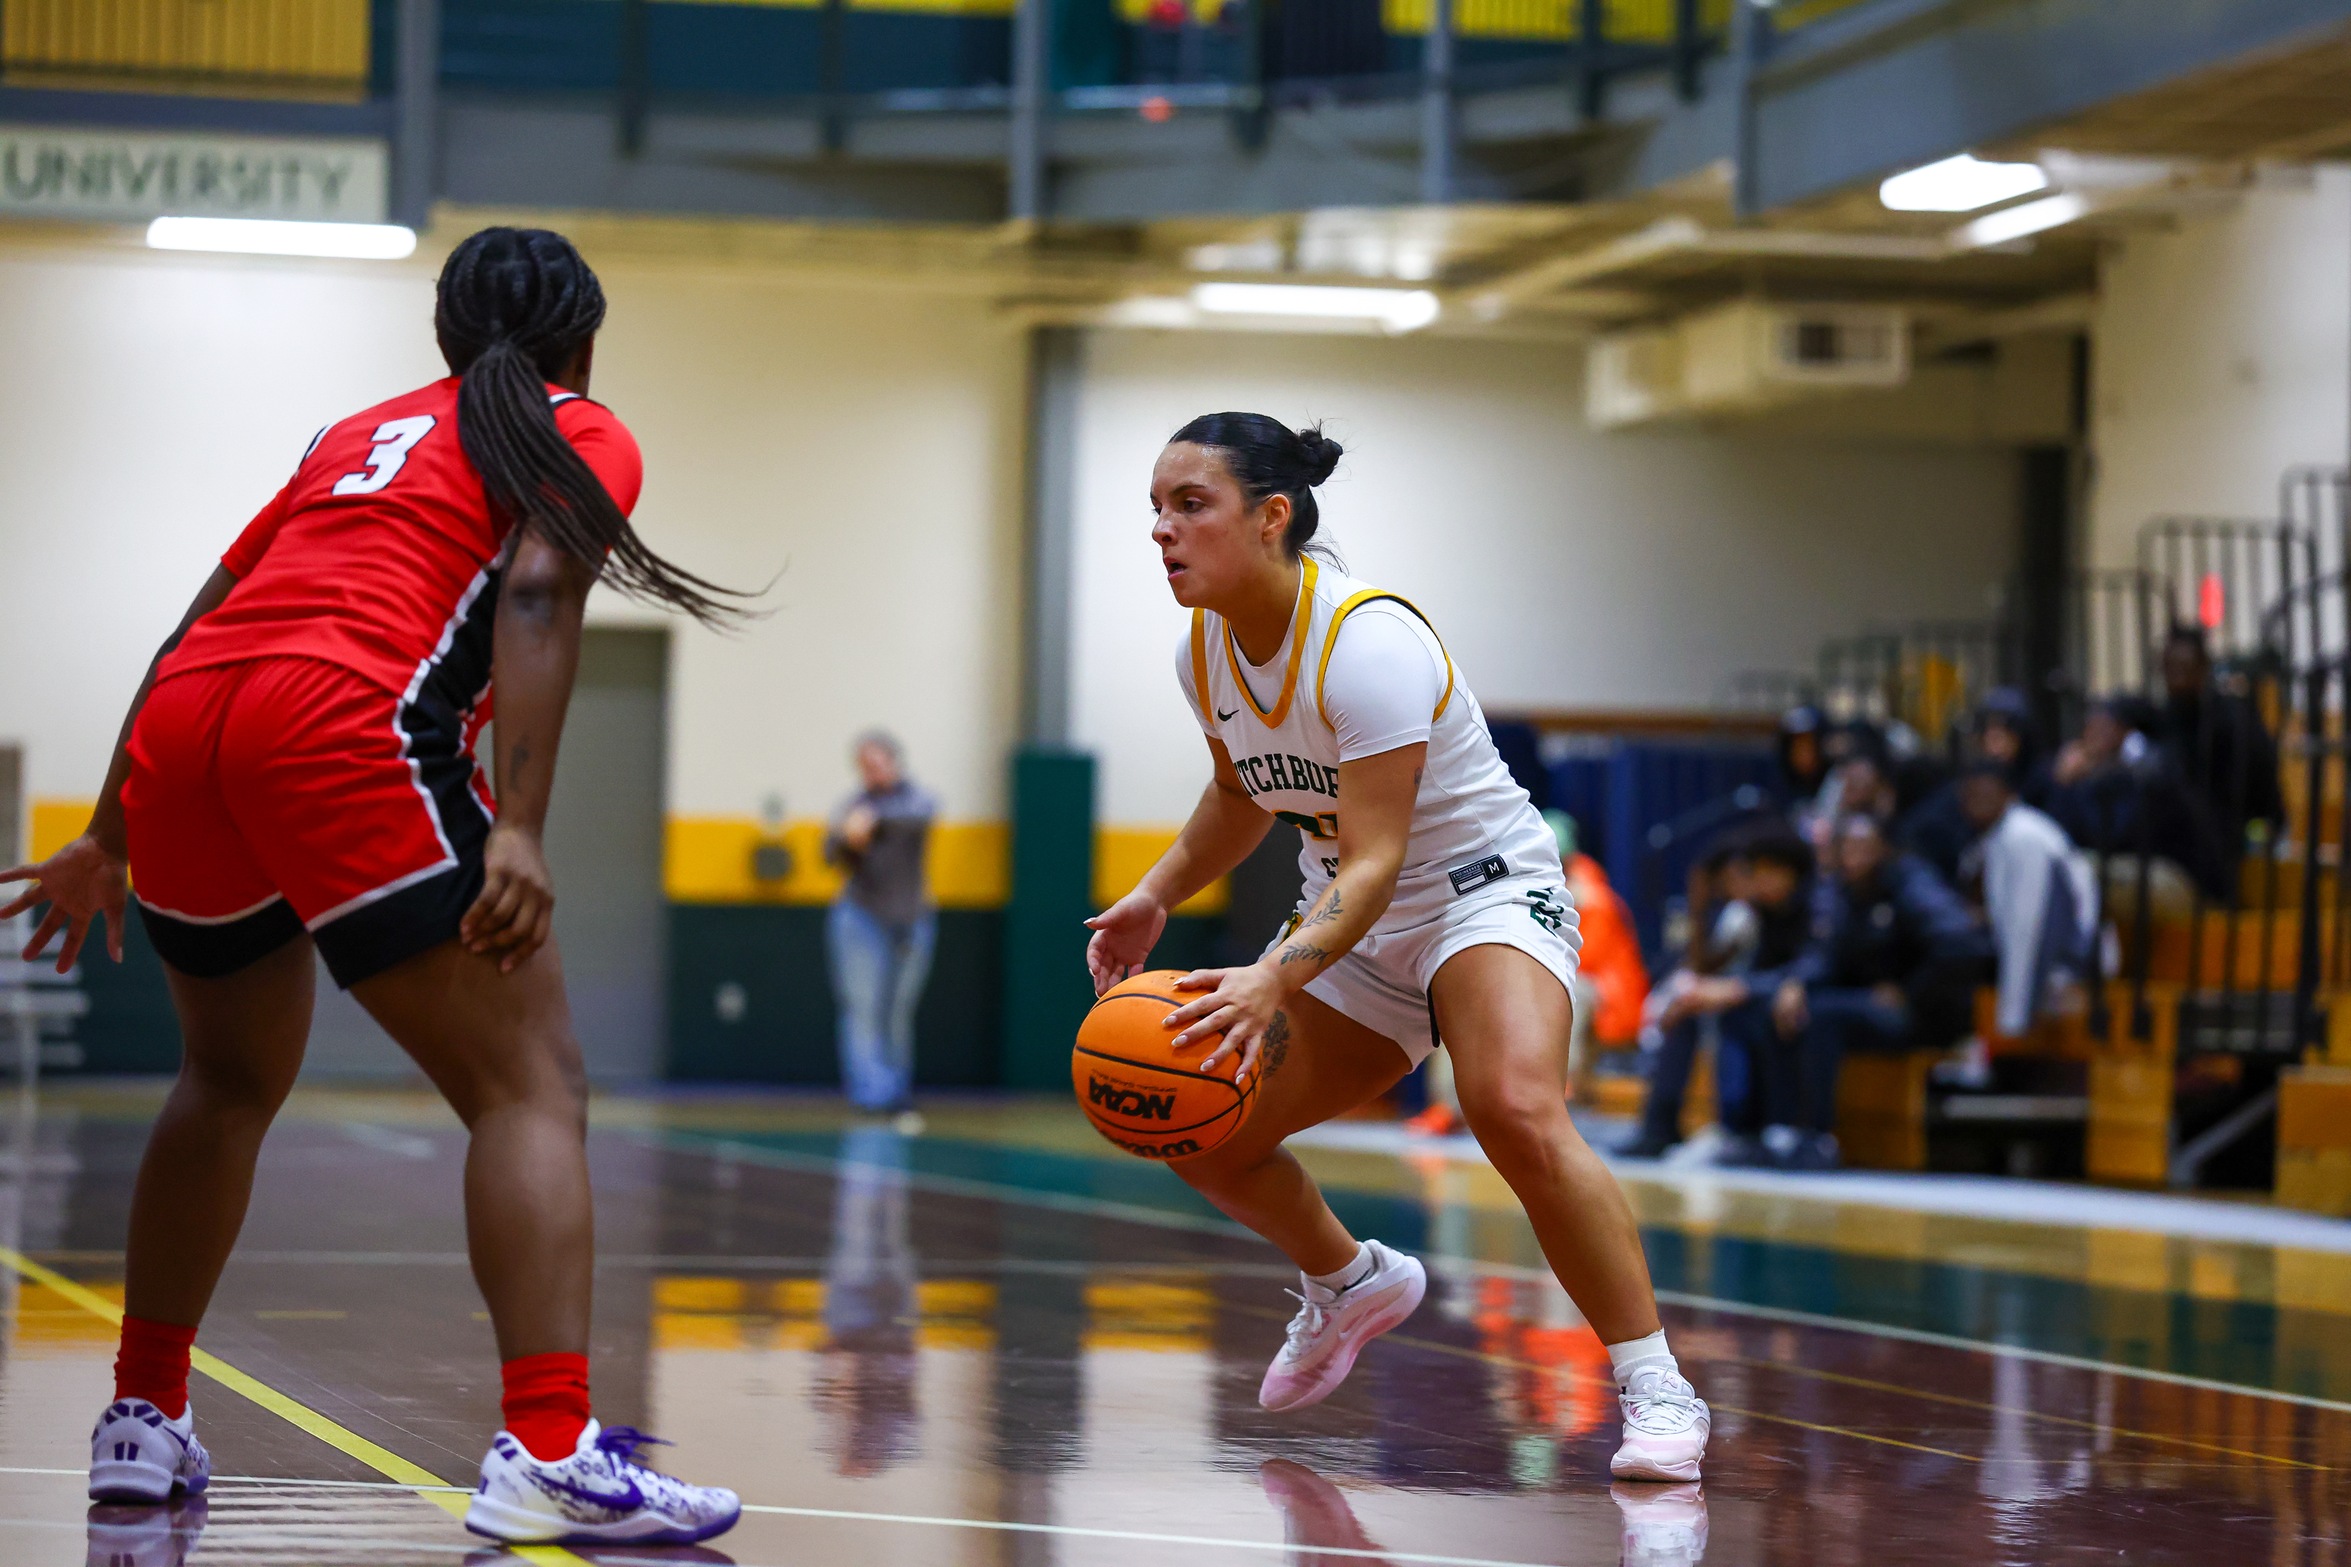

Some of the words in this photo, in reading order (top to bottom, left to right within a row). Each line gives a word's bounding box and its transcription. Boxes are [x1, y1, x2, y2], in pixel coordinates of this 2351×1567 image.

[3, 143, 352, 209] UNIVERSITY
[331, 413, 438, 497] 3
[1488, 861, 1500, 874] M
[1089, 1076, 1176, 1120] NCAA
